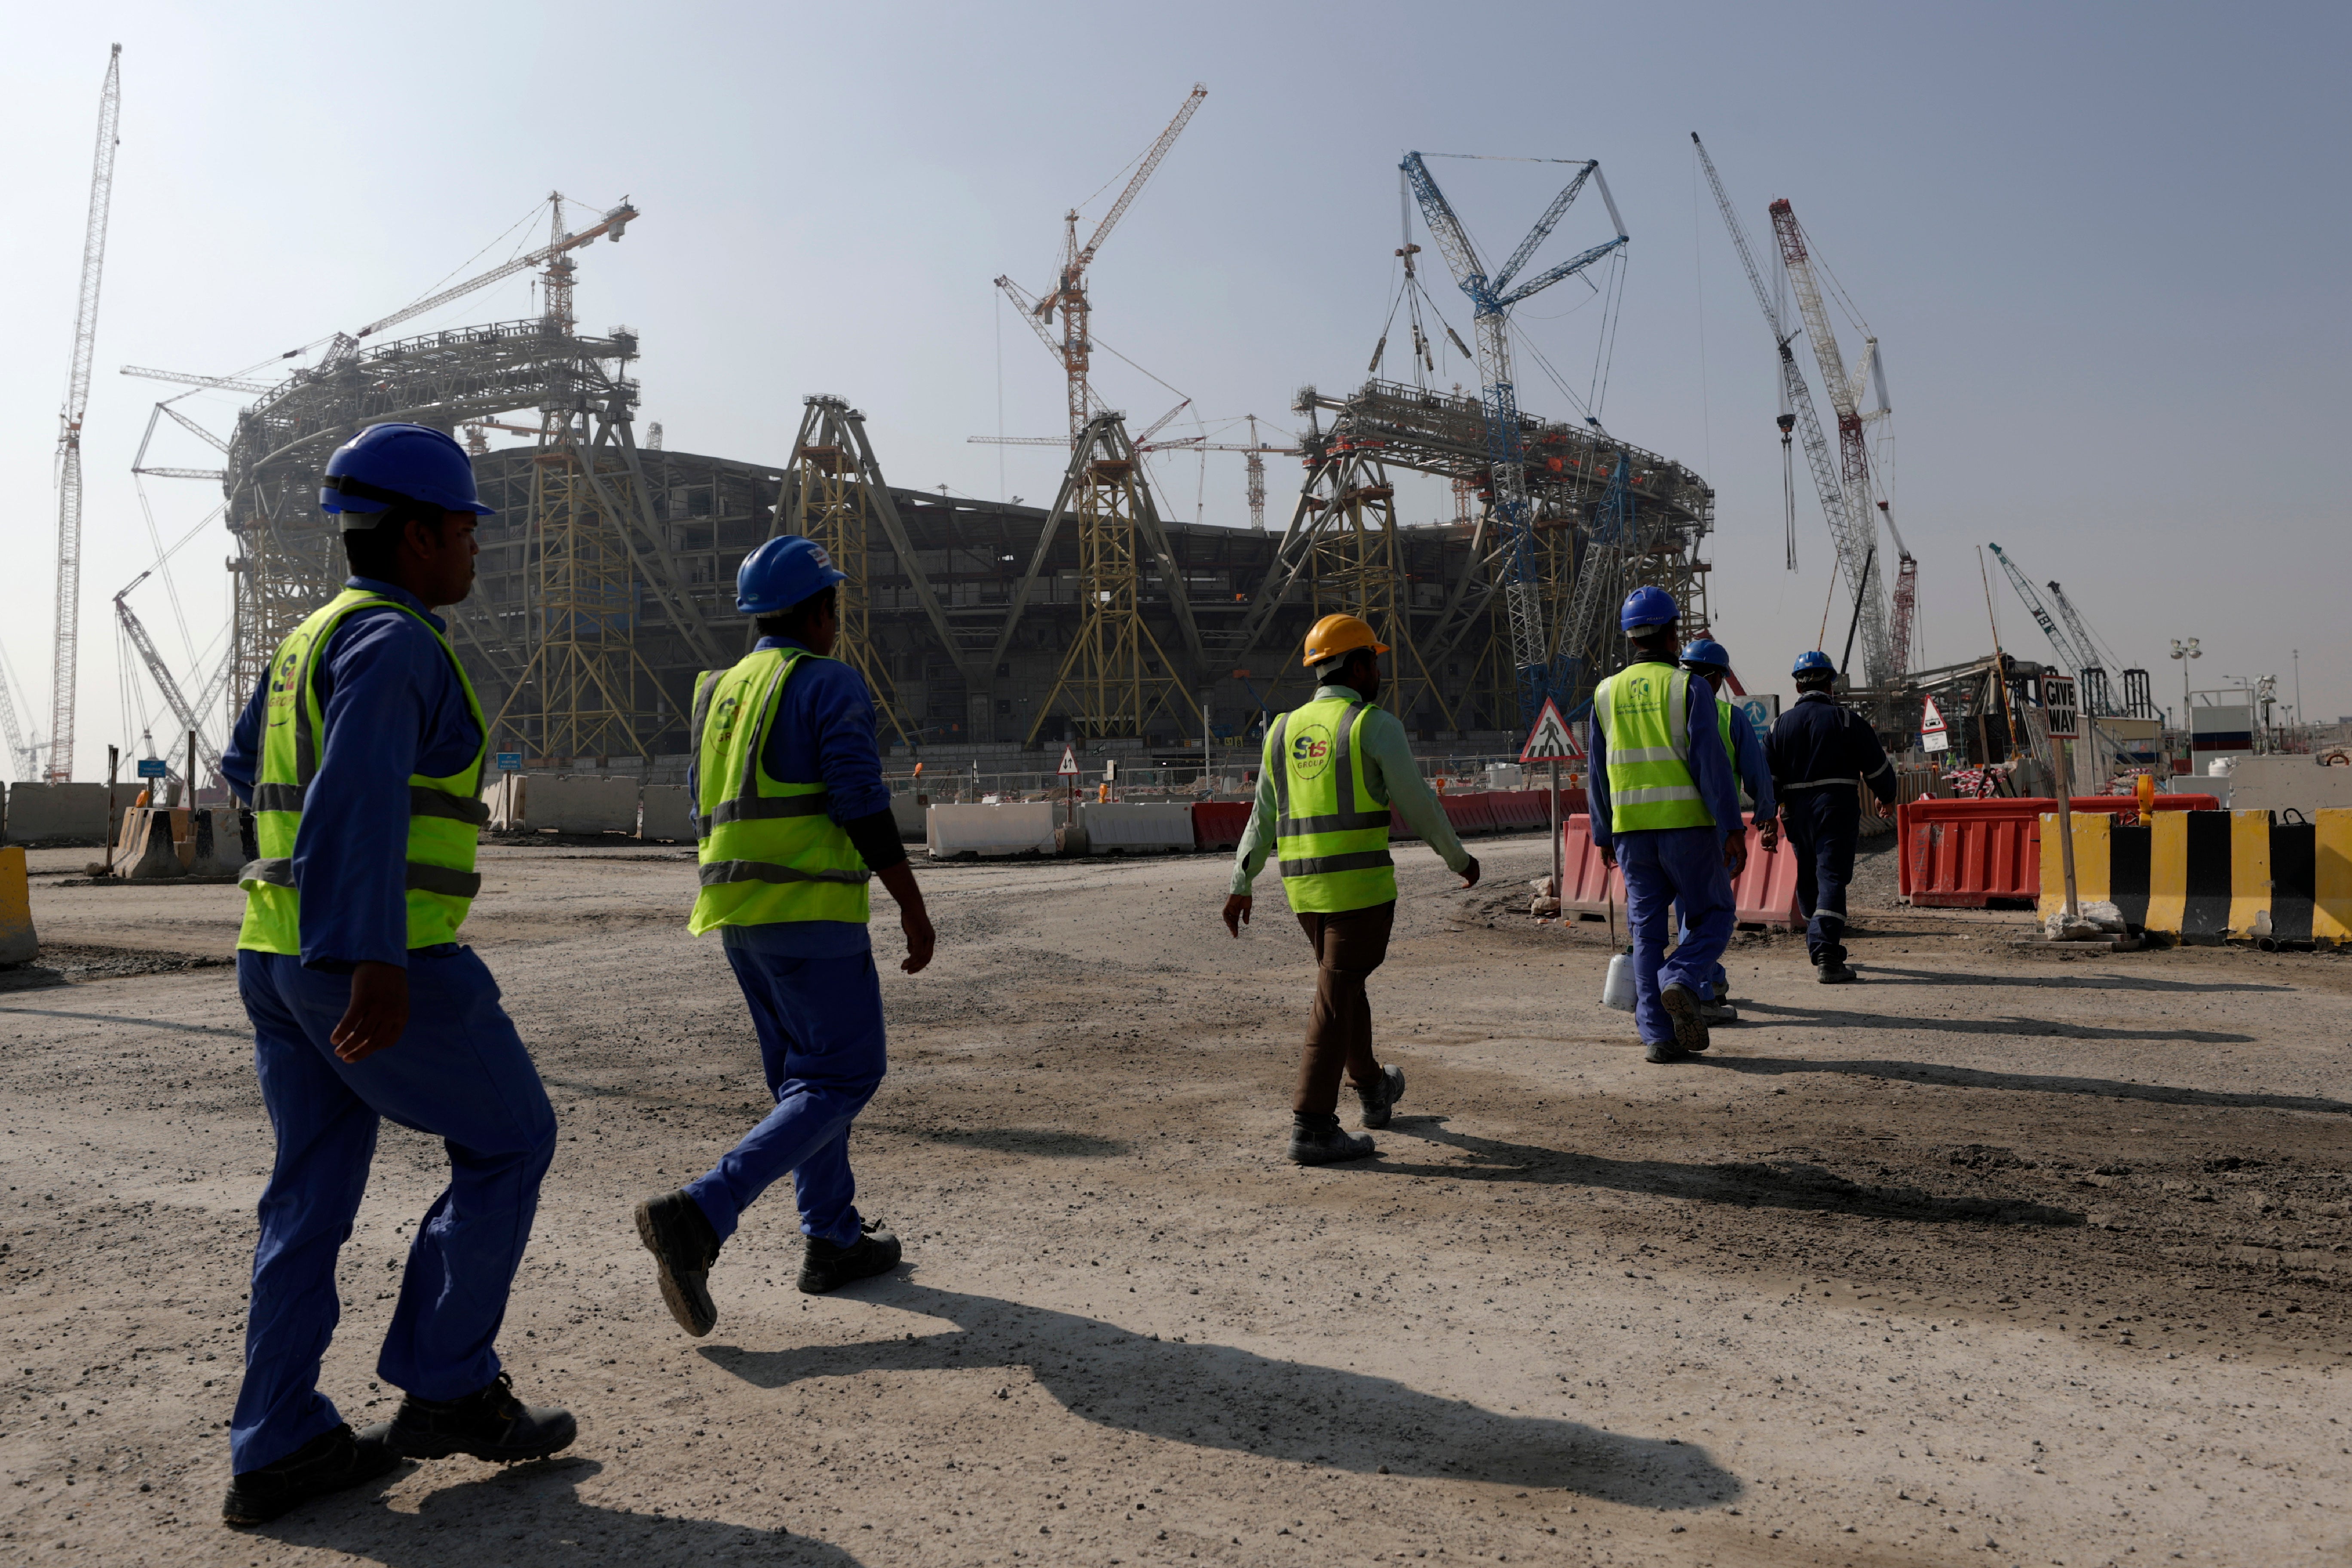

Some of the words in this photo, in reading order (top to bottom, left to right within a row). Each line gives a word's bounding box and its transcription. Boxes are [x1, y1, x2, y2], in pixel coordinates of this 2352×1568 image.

[2046, 681, 2075, 706] GIVE
[2048, 709, 2075, 732] WAY
[1298, 760, 1324, 769] GROUP
